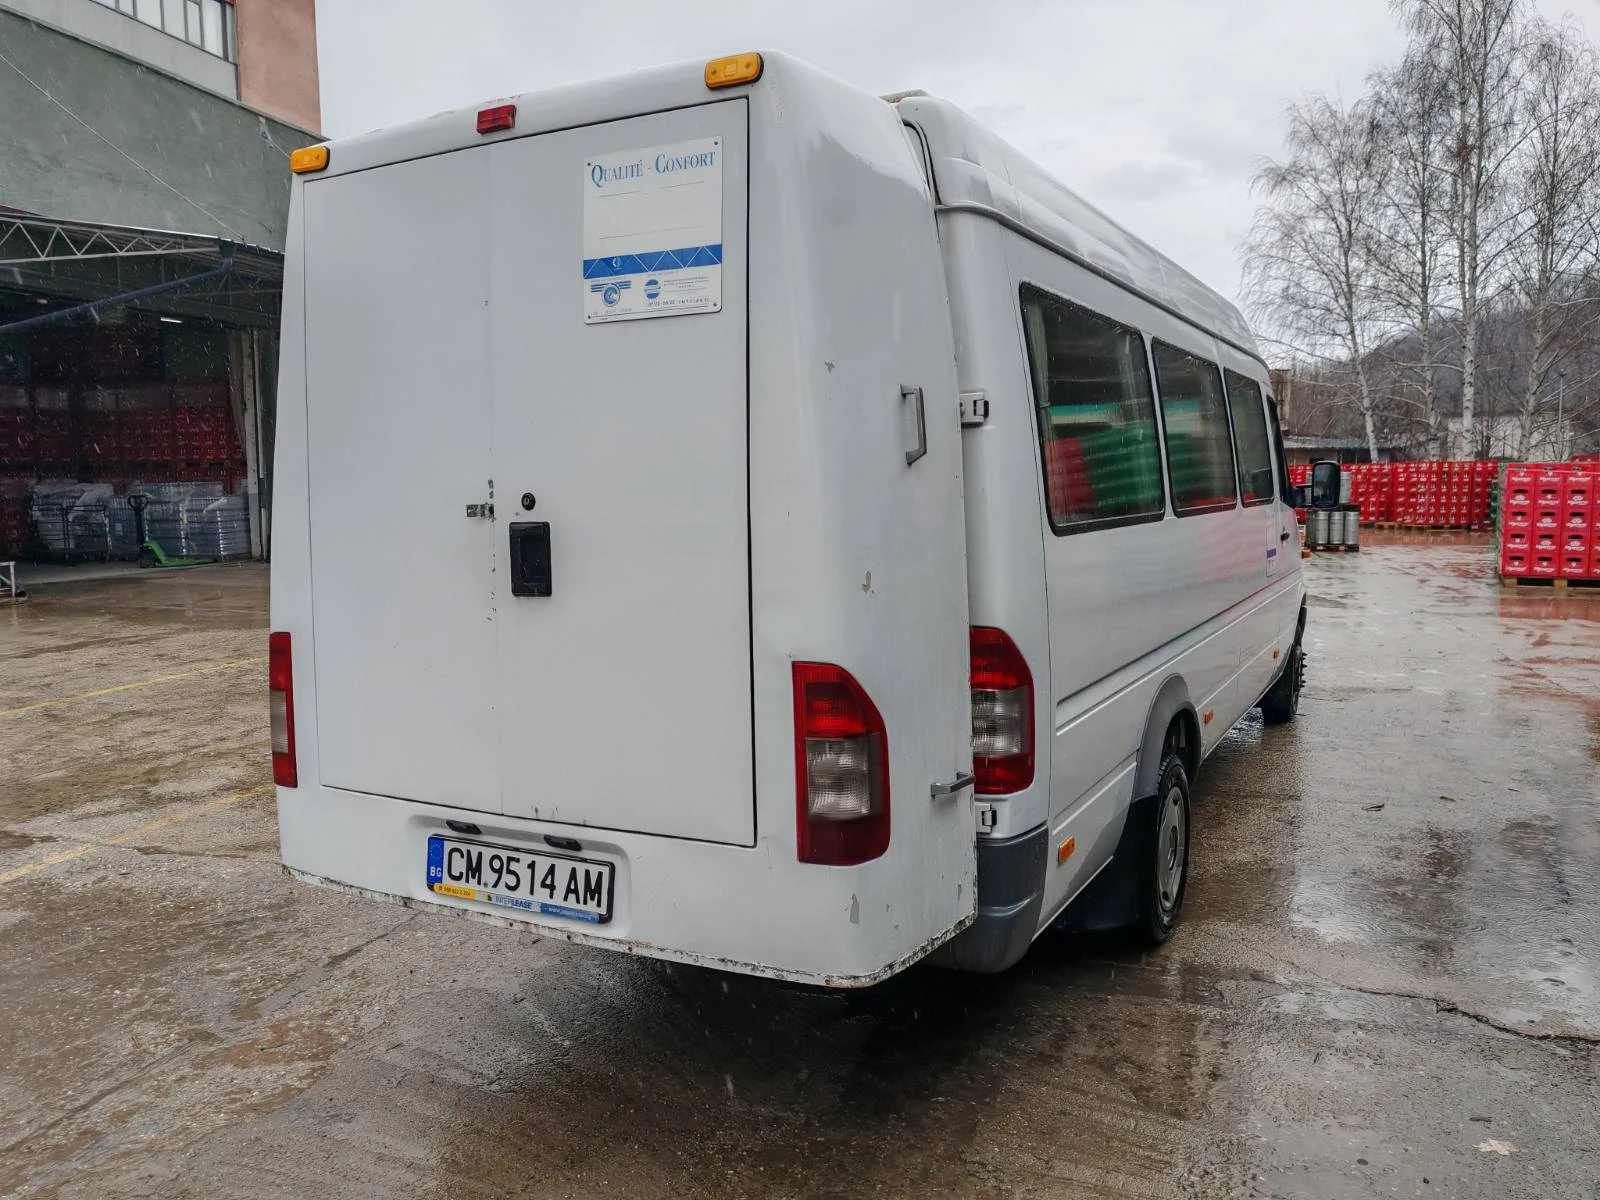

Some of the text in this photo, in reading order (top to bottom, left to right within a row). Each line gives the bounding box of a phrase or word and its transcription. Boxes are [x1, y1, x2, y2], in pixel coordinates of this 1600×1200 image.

[591, 160, 643, 188] QUALITÉ
[655, 151, 716, 174] CONFORT
[430, 866, 442, 877] BG
[495, 895, 532, 910] INTERLEASE
